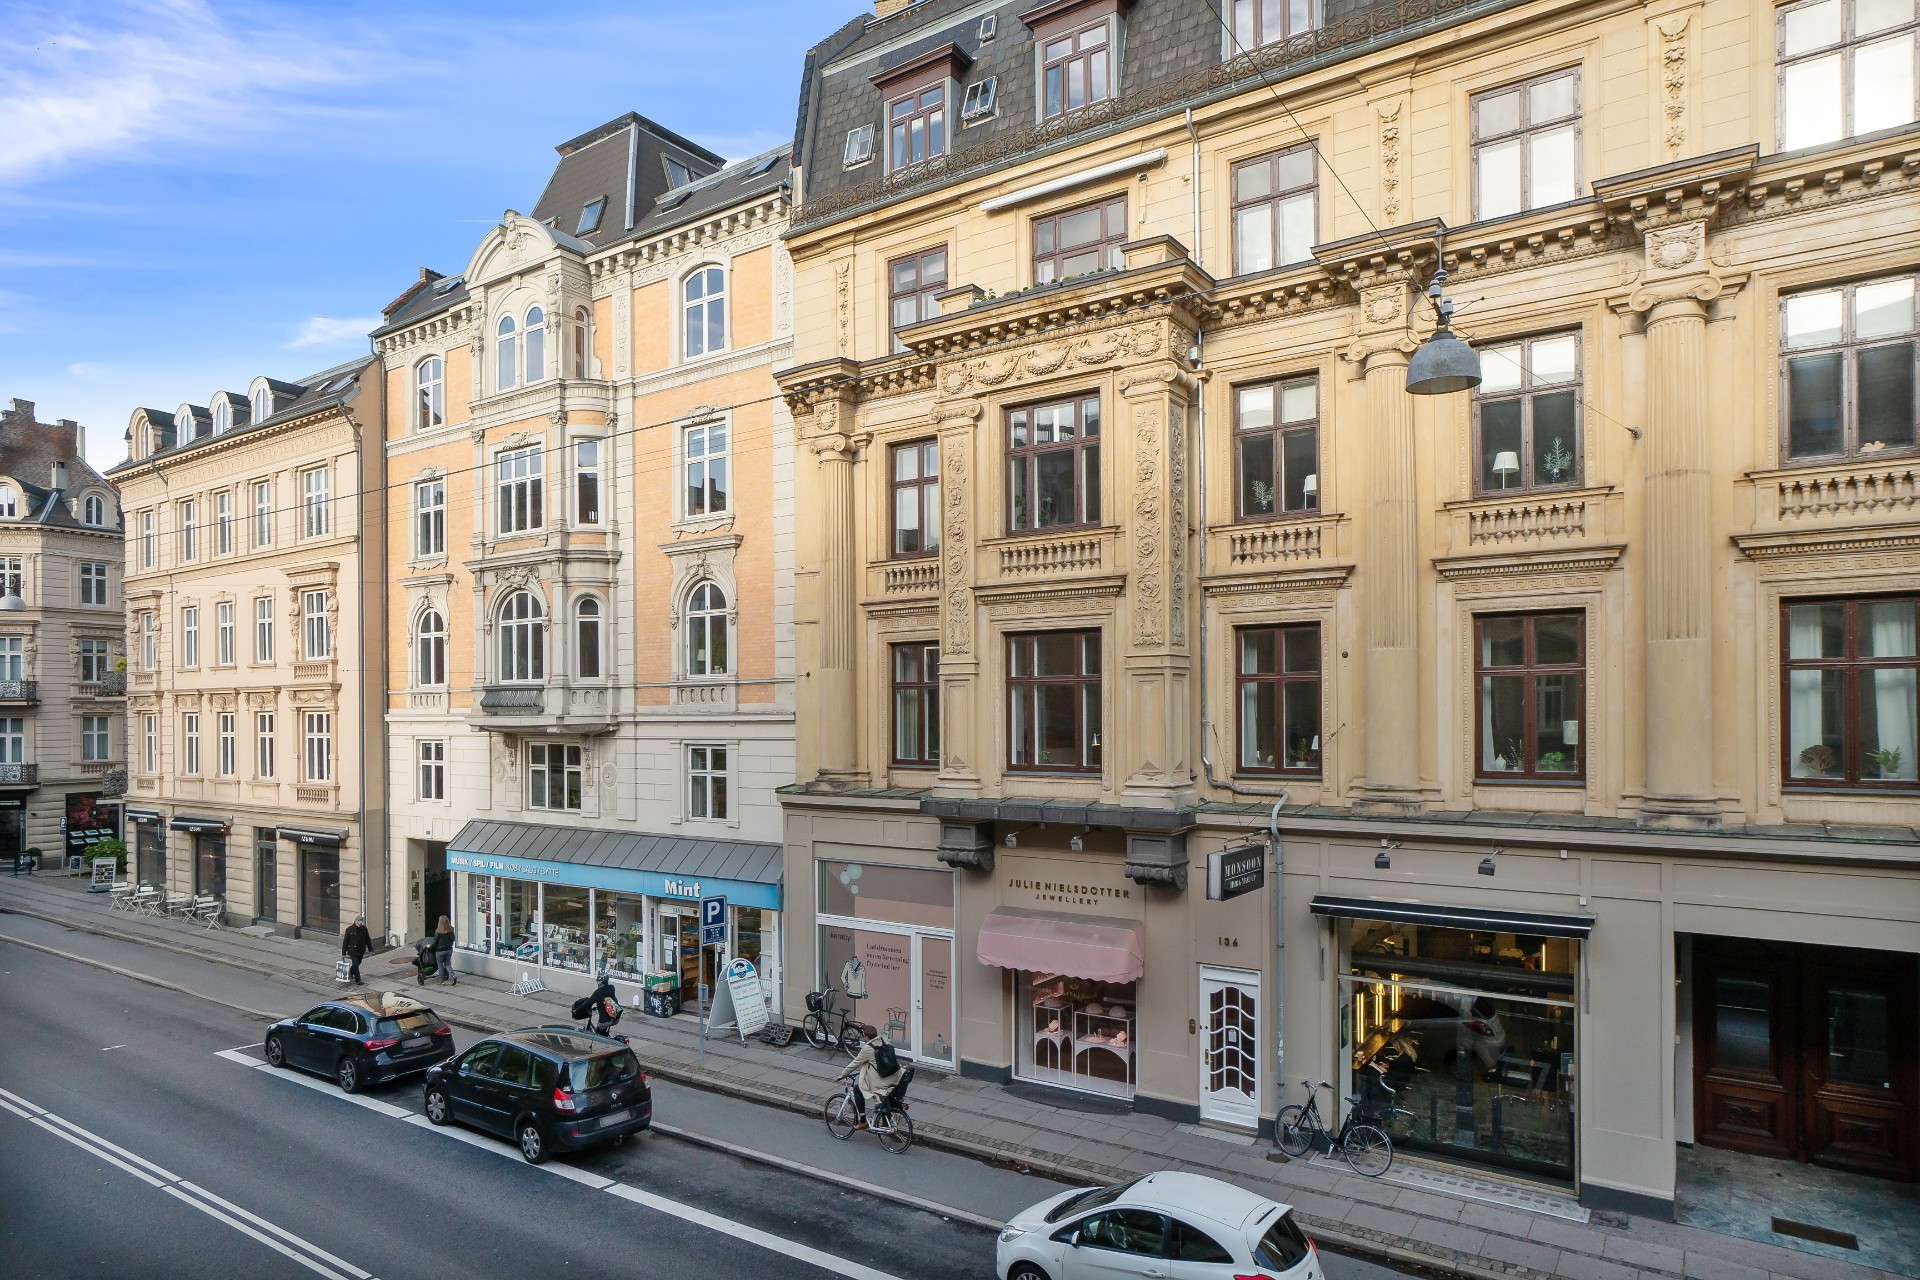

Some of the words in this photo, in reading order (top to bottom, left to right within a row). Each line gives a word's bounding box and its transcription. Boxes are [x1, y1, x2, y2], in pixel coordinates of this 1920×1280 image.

[451, 856, 468, 866] MUSIK
[473, 860, 486, 869] SPIL
[490, 861, 504, 870] FILM
[522, 865, 536, 874] SALG
[541, 867, 559, 877] BYTTE
[1225, 856, 1262, 878] MONSOON
[664, 878, 701, 898] Mint
[1009, 879, 1041, 890] JULIE
[1045, 882, 1129, 899] NIELSDOTTER
[1036, 894, 1098, 905] JEWELLERY
[708, 901, 721, 924] P
[1218, 936, 1239, 947] 136
